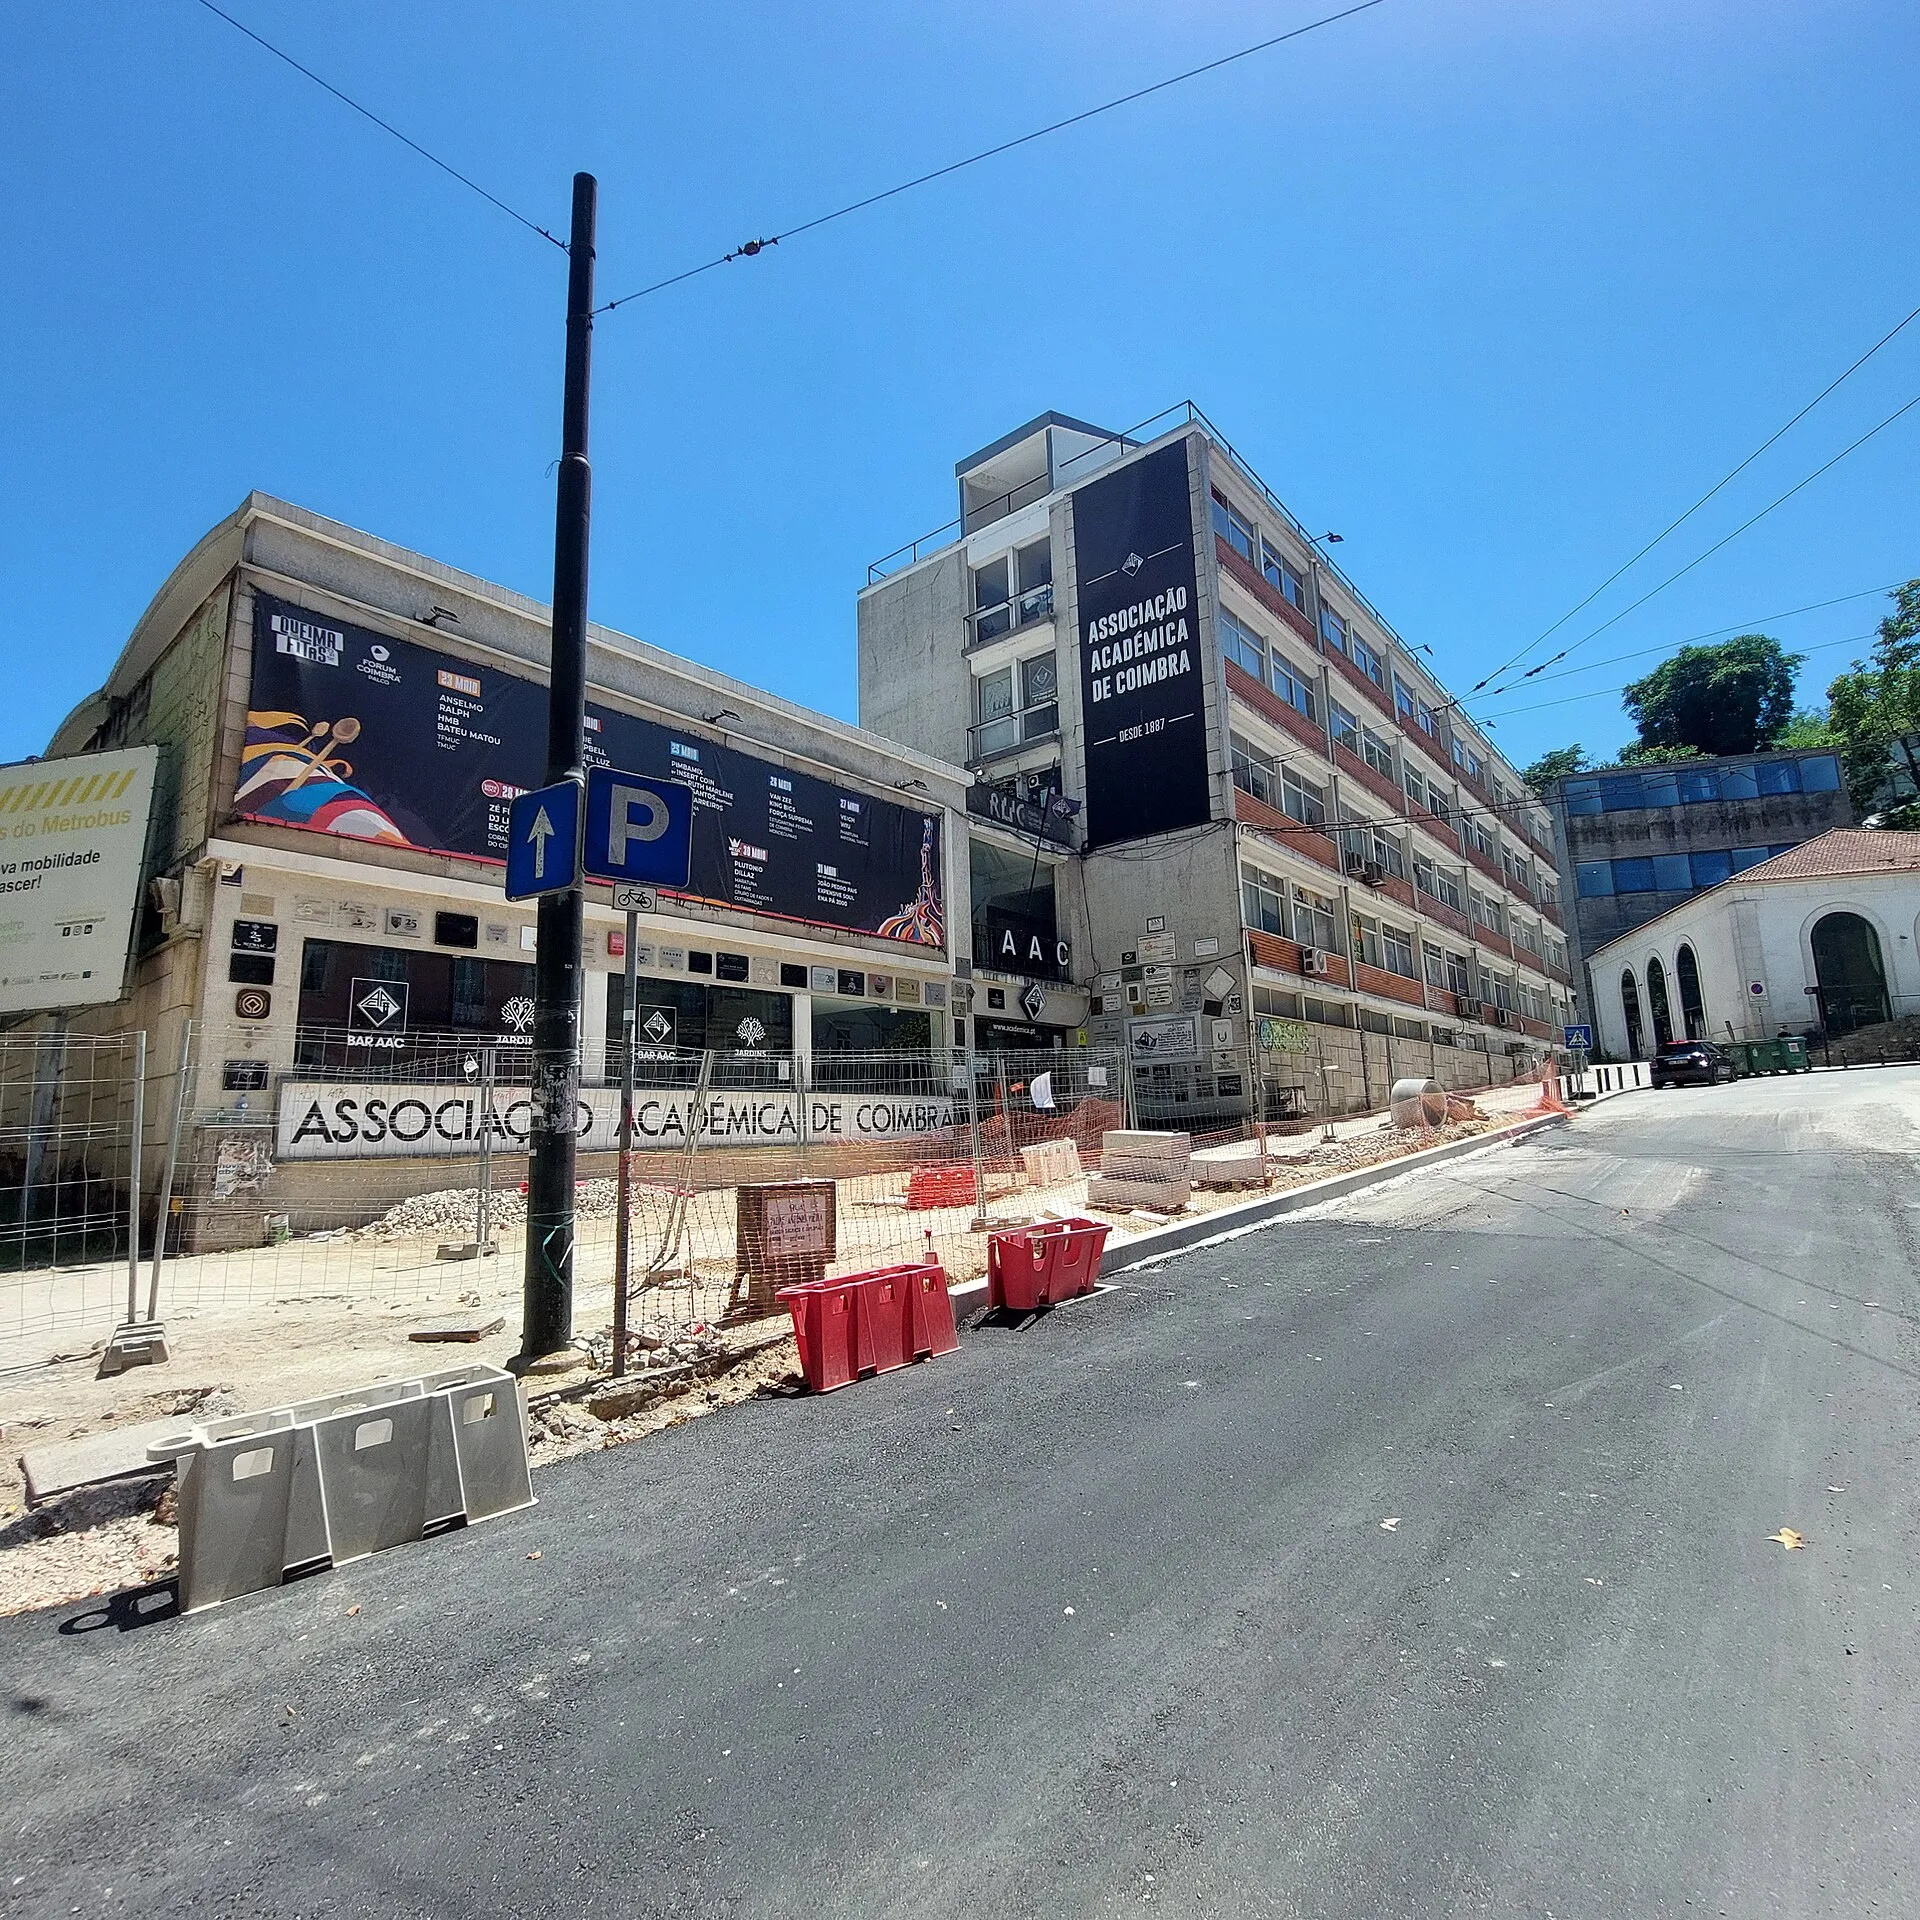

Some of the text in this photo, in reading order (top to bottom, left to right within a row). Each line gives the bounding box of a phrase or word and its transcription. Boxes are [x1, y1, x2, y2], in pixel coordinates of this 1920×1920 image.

[1088, 585, 1187, 644] ASSOCIAÇÃO
[280, 615, 337, 650] QUEIMA
[287, 637, 327, 664] FITAS
[1090, 617, 1189, 674] ACADÉMICA
[356, 664, 401, 683] COIMBRA
[362, 658, 397, 675] FORUM
[368, 675, 390, 686] PALCO
[454, 676, 478, 694] MAIO
[1092, 649, 1191, 703] DE COIMBRA
[439, 694, 484, 712] ANSELMO
[439, 704, 470, 718] RALPH
[437, 713, 460, 726] HMB
[437, 722, 501, 745] BATEU MATOU
[1119, 717, 1165, 743] DESDE 1887
[436, 741, 456, 751] TMUC
[595, 756, 611, 767] LUZ
[676, 769, 699, 782] INSERT
[699, 775, 715, 787] COIN
[502, 785, 513, 799] 28
[705, 785, 734, 800] MARLENE
[769, 792, 781, 801] VAN
[489, 804, 500, 814] ZÉ
[769, 808, 814, 826] FORÇA SUPREMA
[41, 809, 131, 835] Metrobus
[489, 814, 500, 823] DJ
[607, 783, 669, 866] P
[21, 849, 101, 872] mobilidade
[734, 869, 755, 879] DILLAZ
[0, 874, 42, 894] ascer!
[347, 1035, 405, 1050] BAR AAC
[637, 1050, 676, 1061] BAR AAC
[734, 1048, 767, 1058] JARDINS
[812, 1102, 842, 1134] DE
[855, 1103, 953, 1133] COIMBRA
